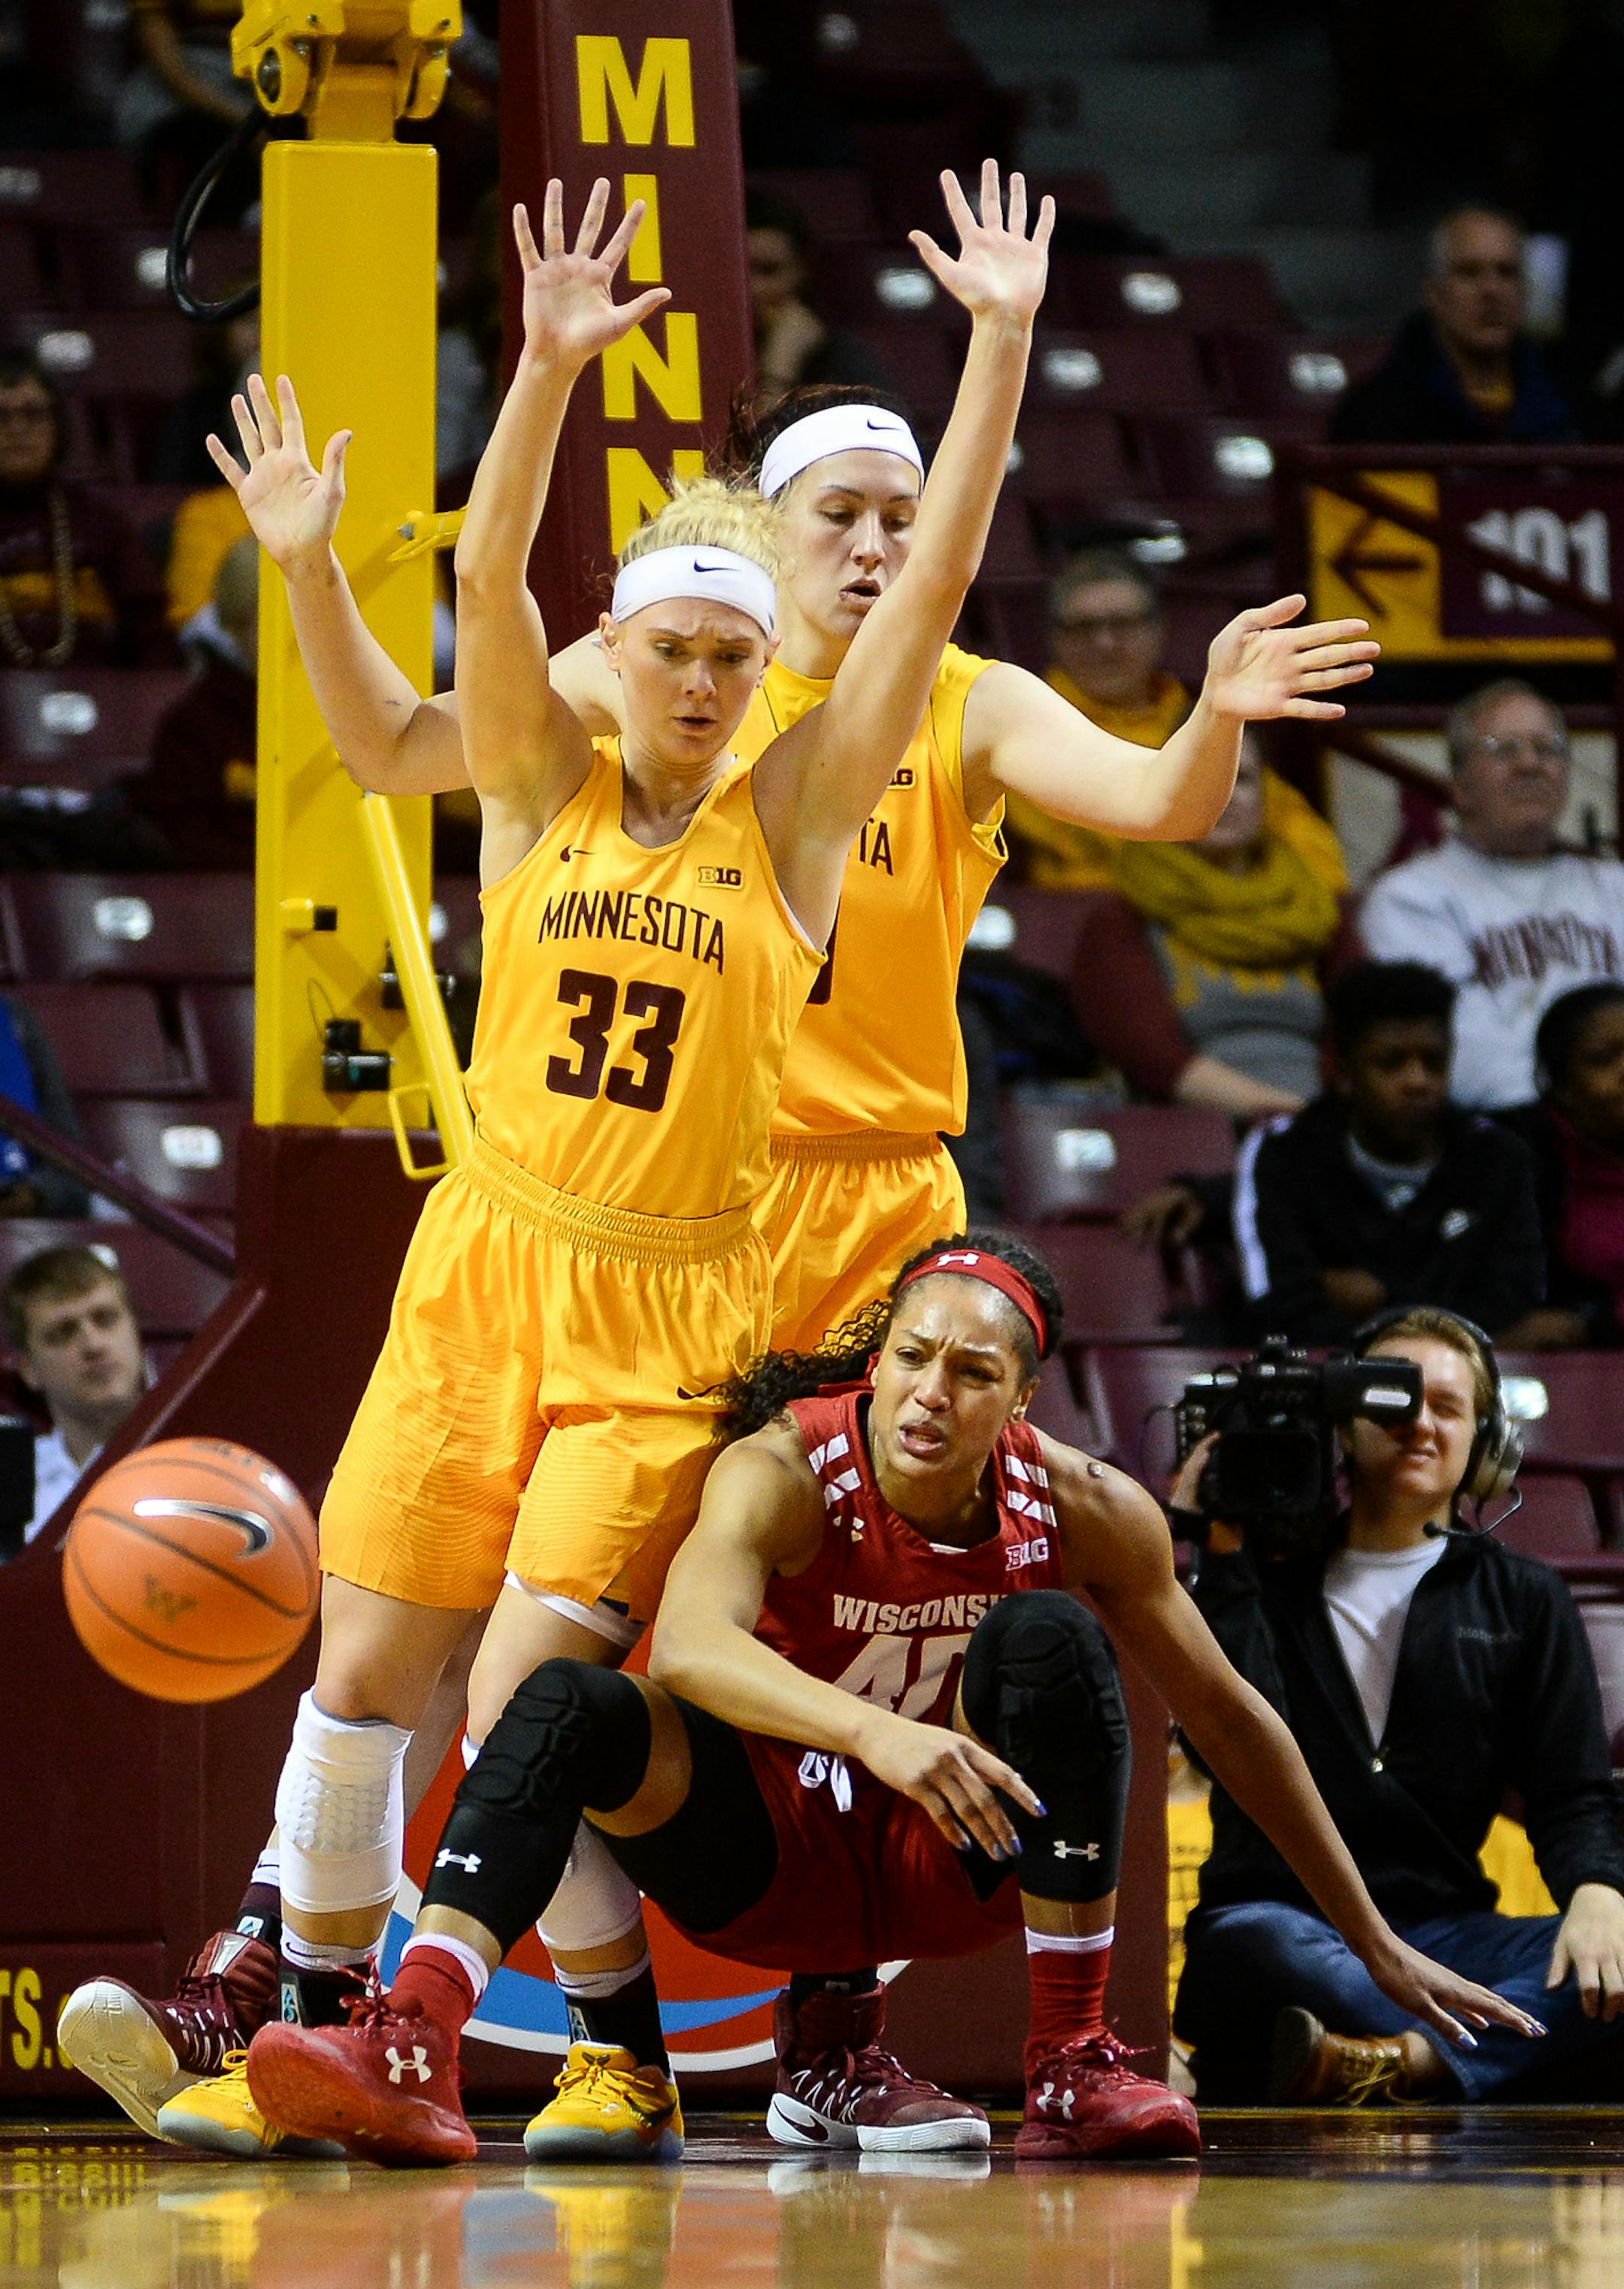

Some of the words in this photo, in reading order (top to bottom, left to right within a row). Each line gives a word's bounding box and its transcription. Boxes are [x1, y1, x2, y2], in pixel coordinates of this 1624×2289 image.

[538, 890, 724, 975] MINNESOTA
[546, 969, 686, 1112] 33
[833, 1593, 1008, 1633] WISCONS
